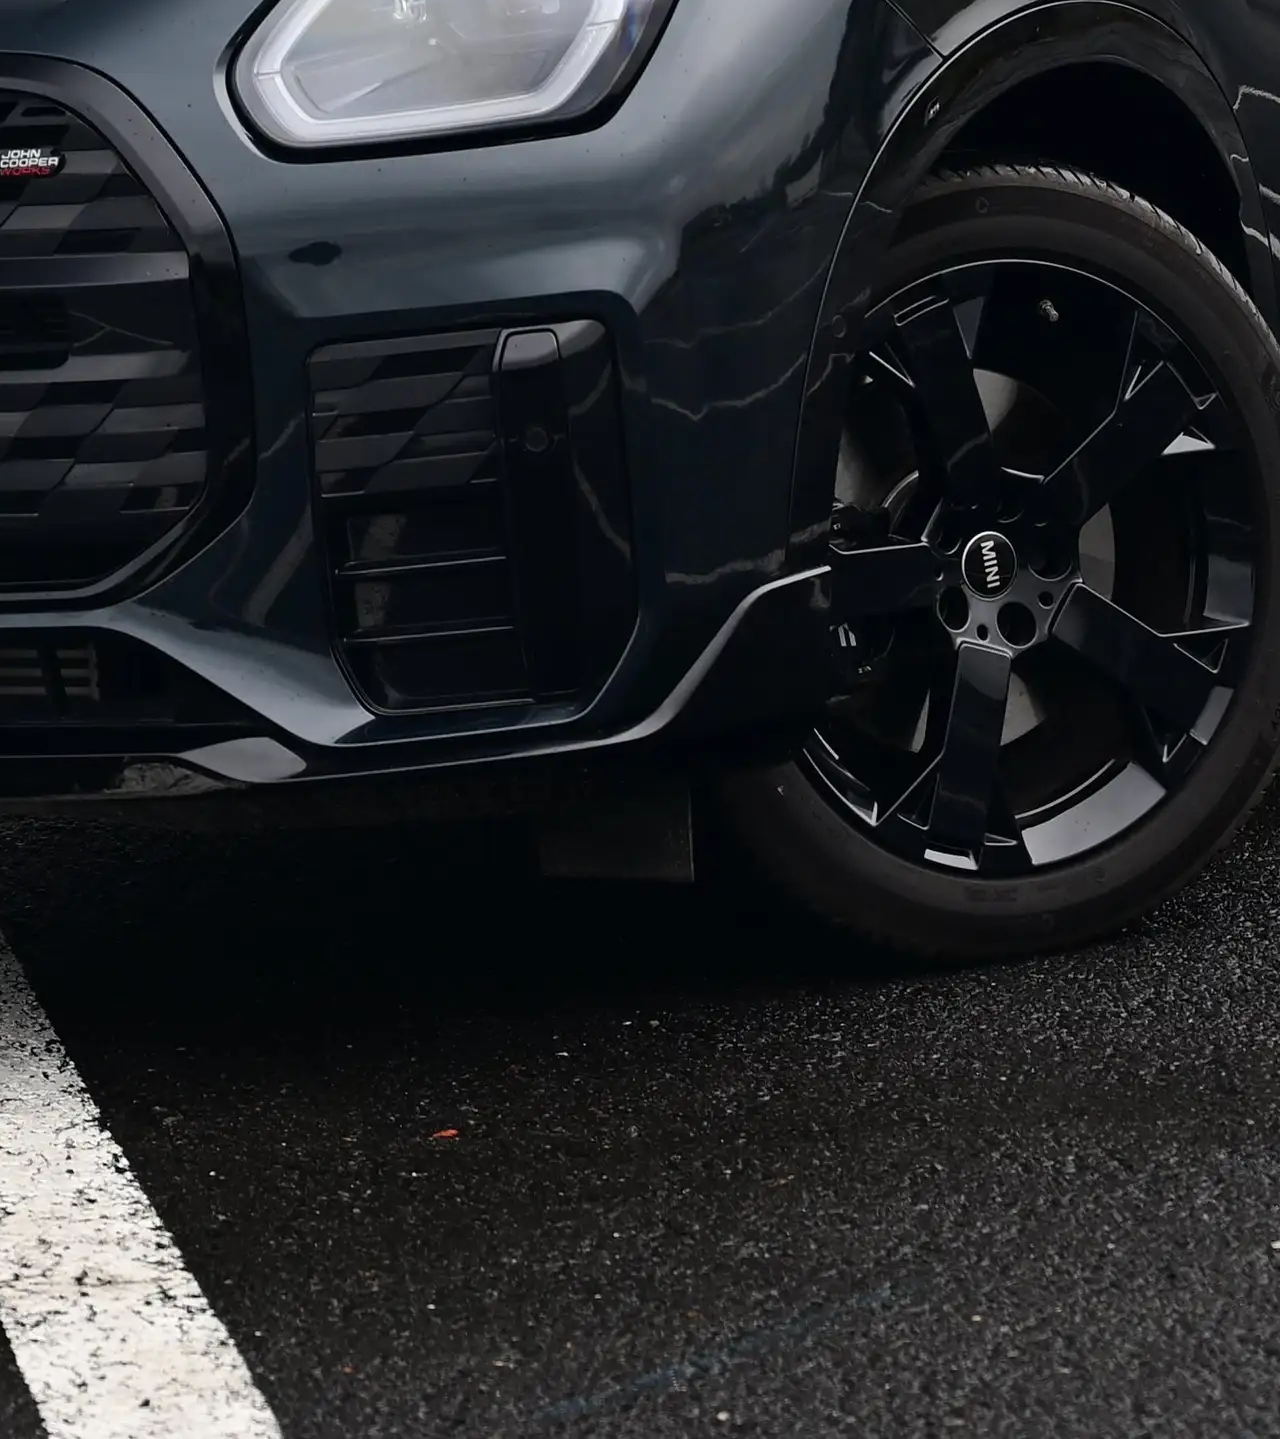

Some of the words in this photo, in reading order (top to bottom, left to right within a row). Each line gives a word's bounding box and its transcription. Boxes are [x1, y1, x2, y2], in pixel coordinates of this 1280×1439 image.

[1, 148, 41, 159] JOHN
[0, 157, 59, 168] COOPER
[0, 167, 50, 176] WORKS
[980, 539, 1000, 589] MINI
